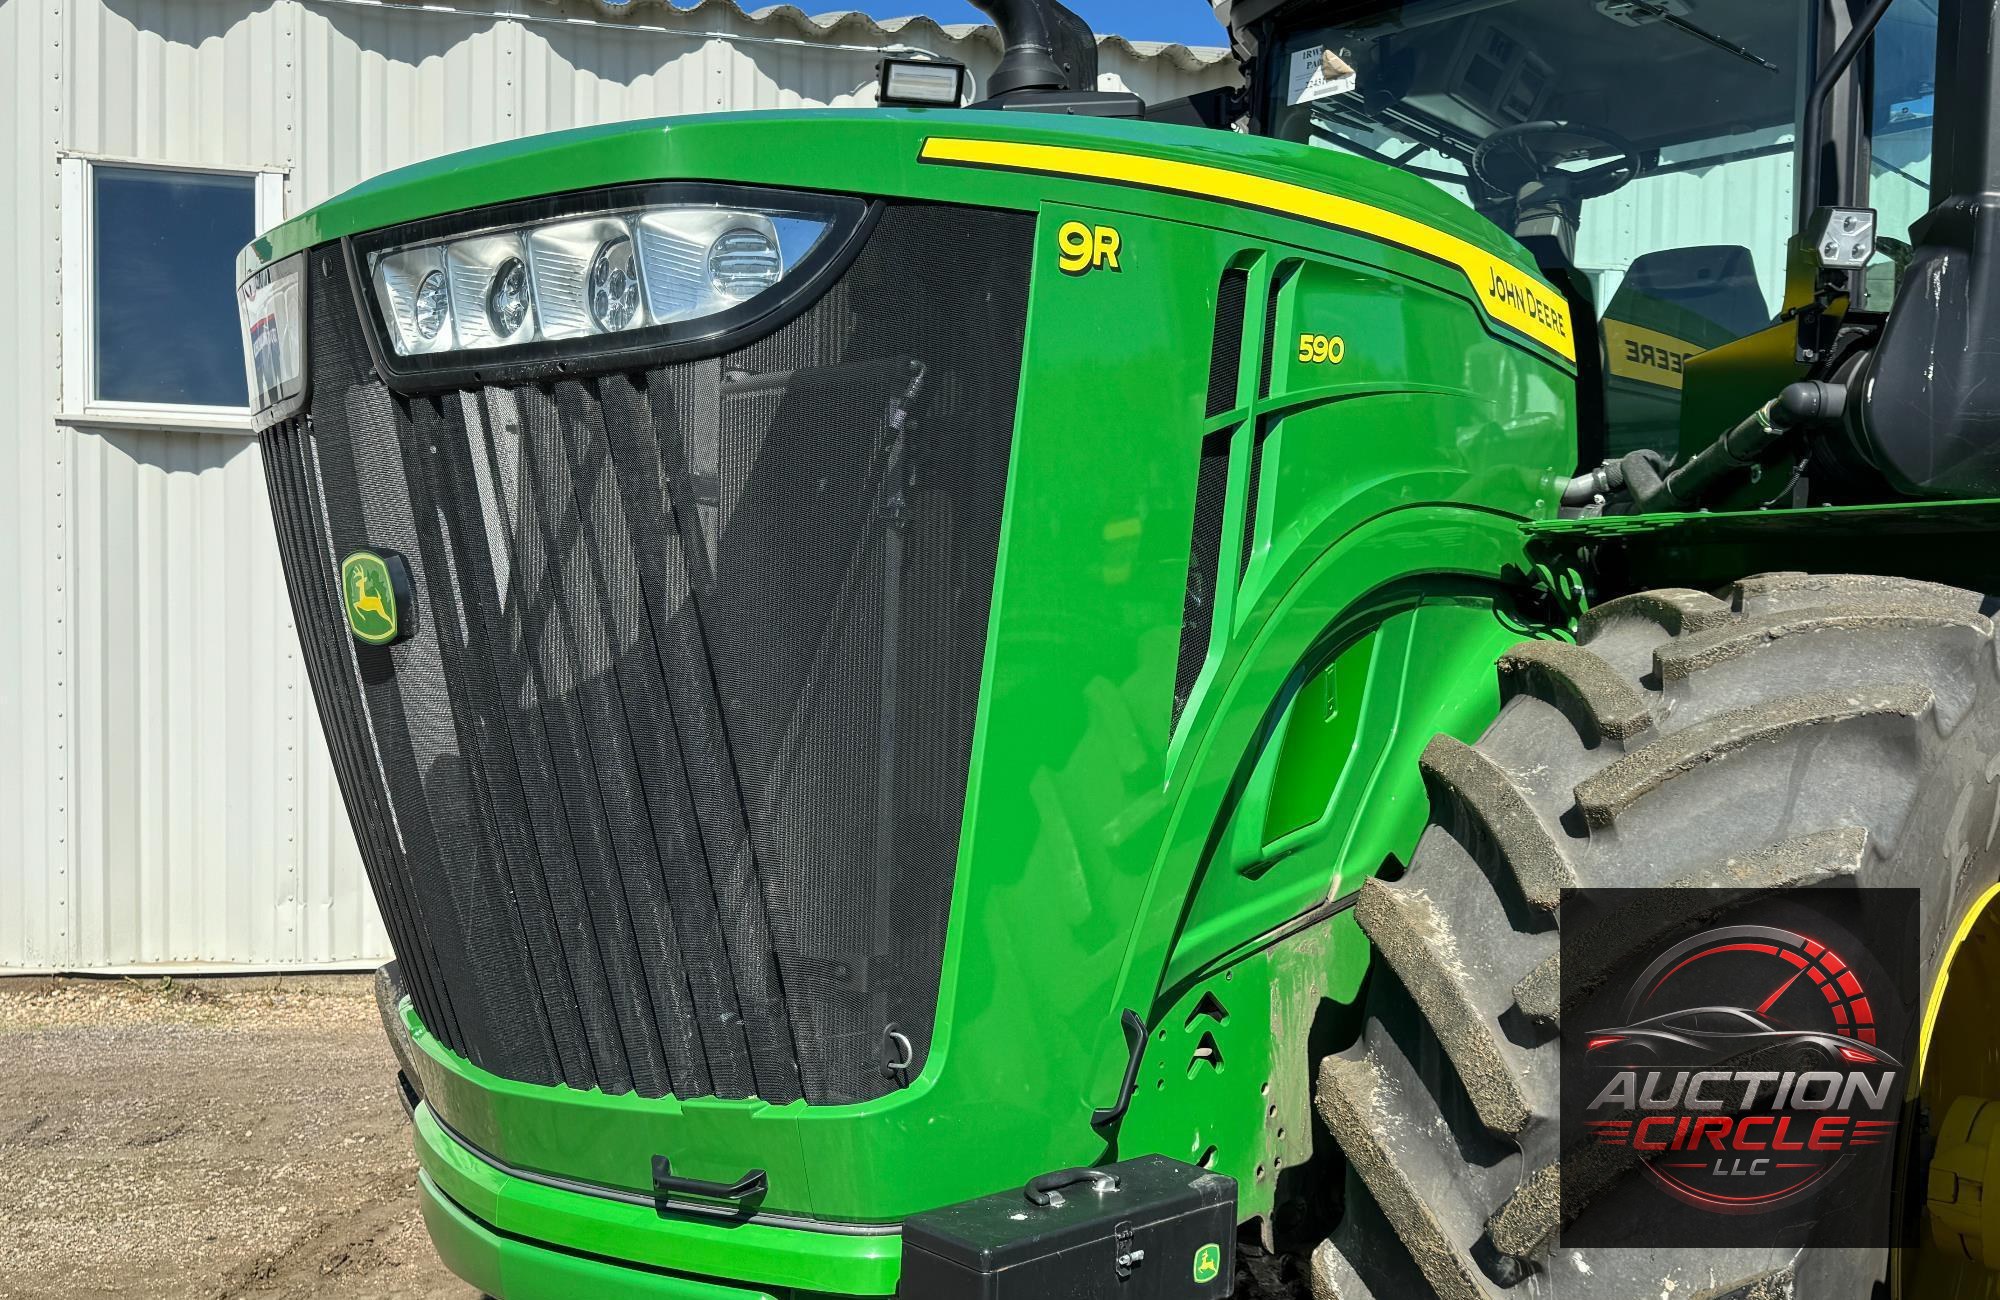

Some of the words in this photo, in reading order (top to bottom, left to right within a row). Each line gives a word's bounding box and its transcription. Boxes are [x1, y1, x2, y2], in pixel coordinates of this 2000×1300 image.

[1058, 220, 1122, 277] 9R
[1489, 266, 1526, 314] JOHN
[1525, 287, 1567, 338] DEERE
[1298, 333, 1345, 364] 590
